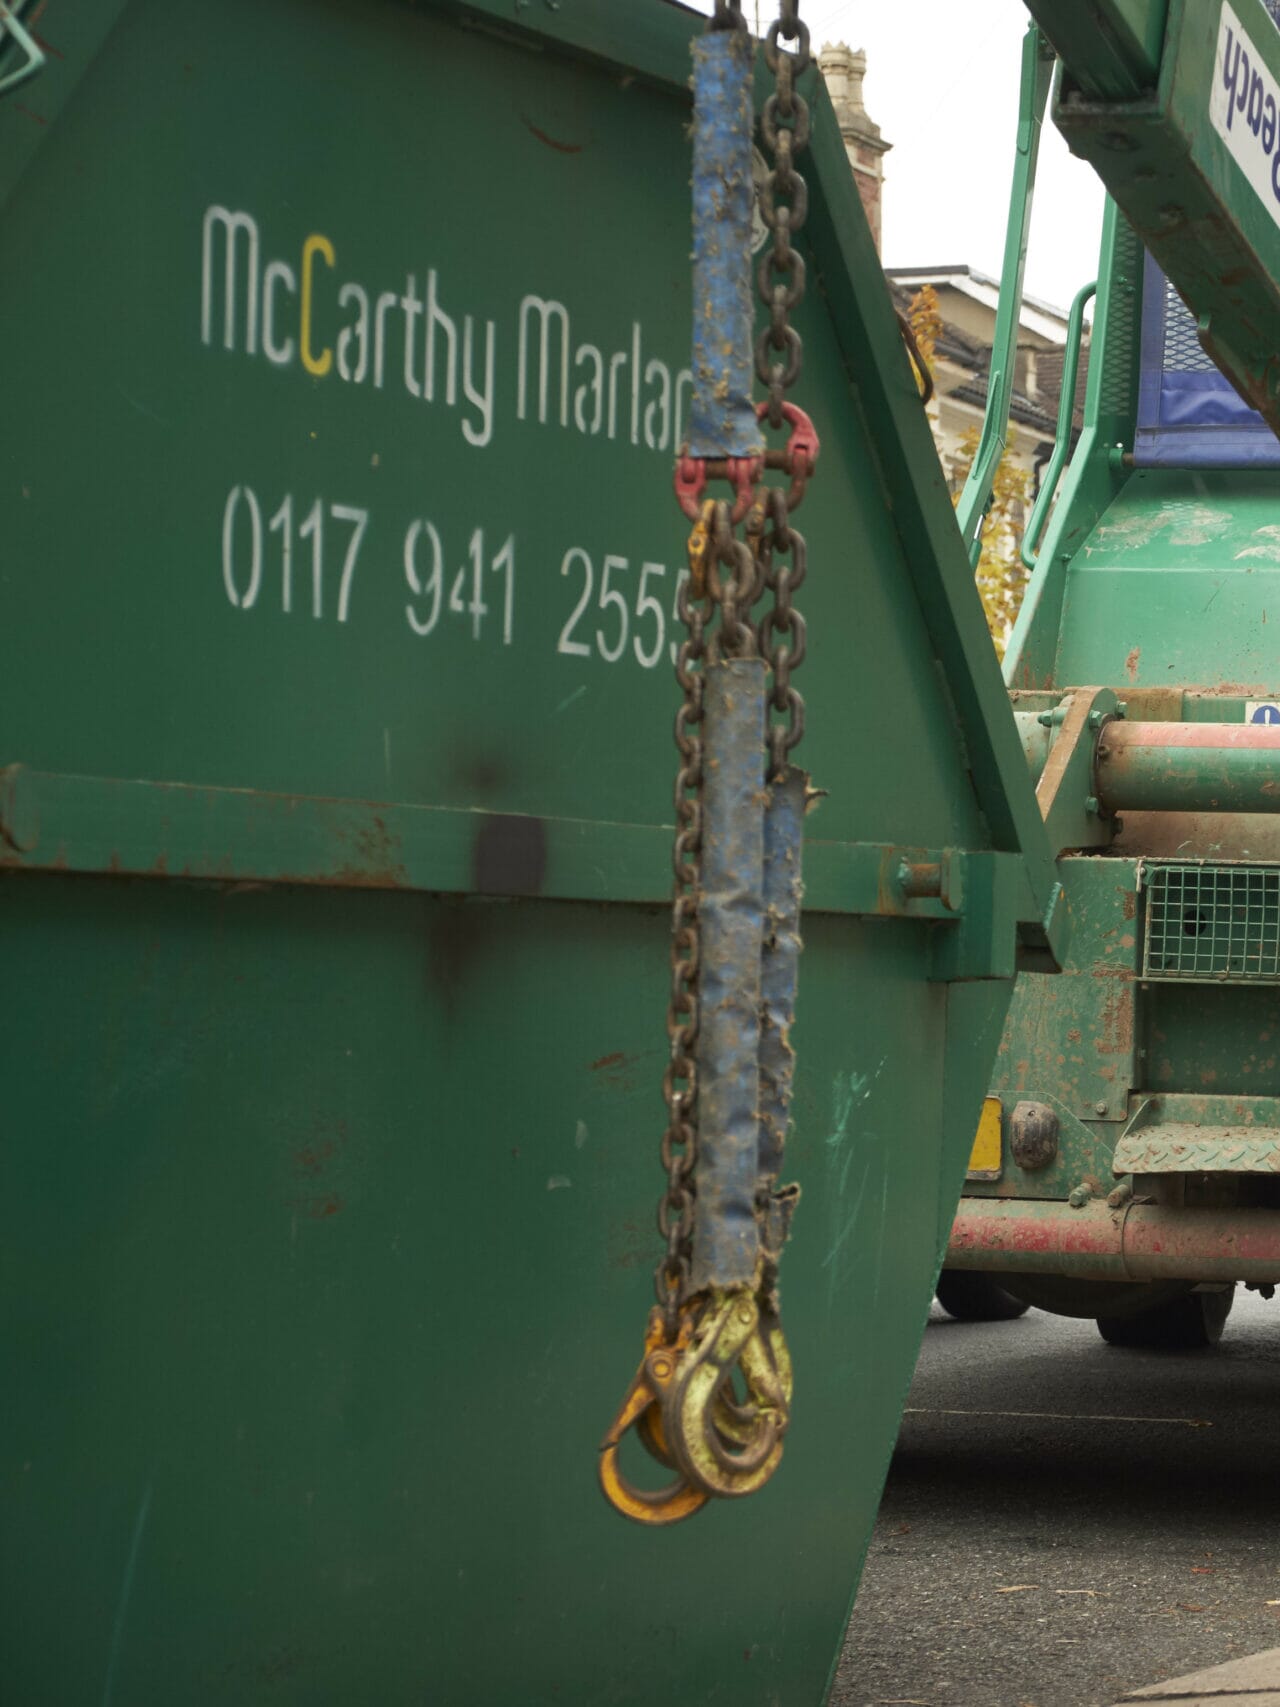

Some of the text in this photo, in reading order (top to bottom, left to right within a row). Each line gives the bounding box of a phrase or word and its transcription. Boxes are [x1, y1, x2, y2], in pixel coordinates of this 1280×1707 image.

[202, 204, 495, 447] McCarthy
[222, 485, 368, 623] 0117
[404, 519, 515, 644] 941
